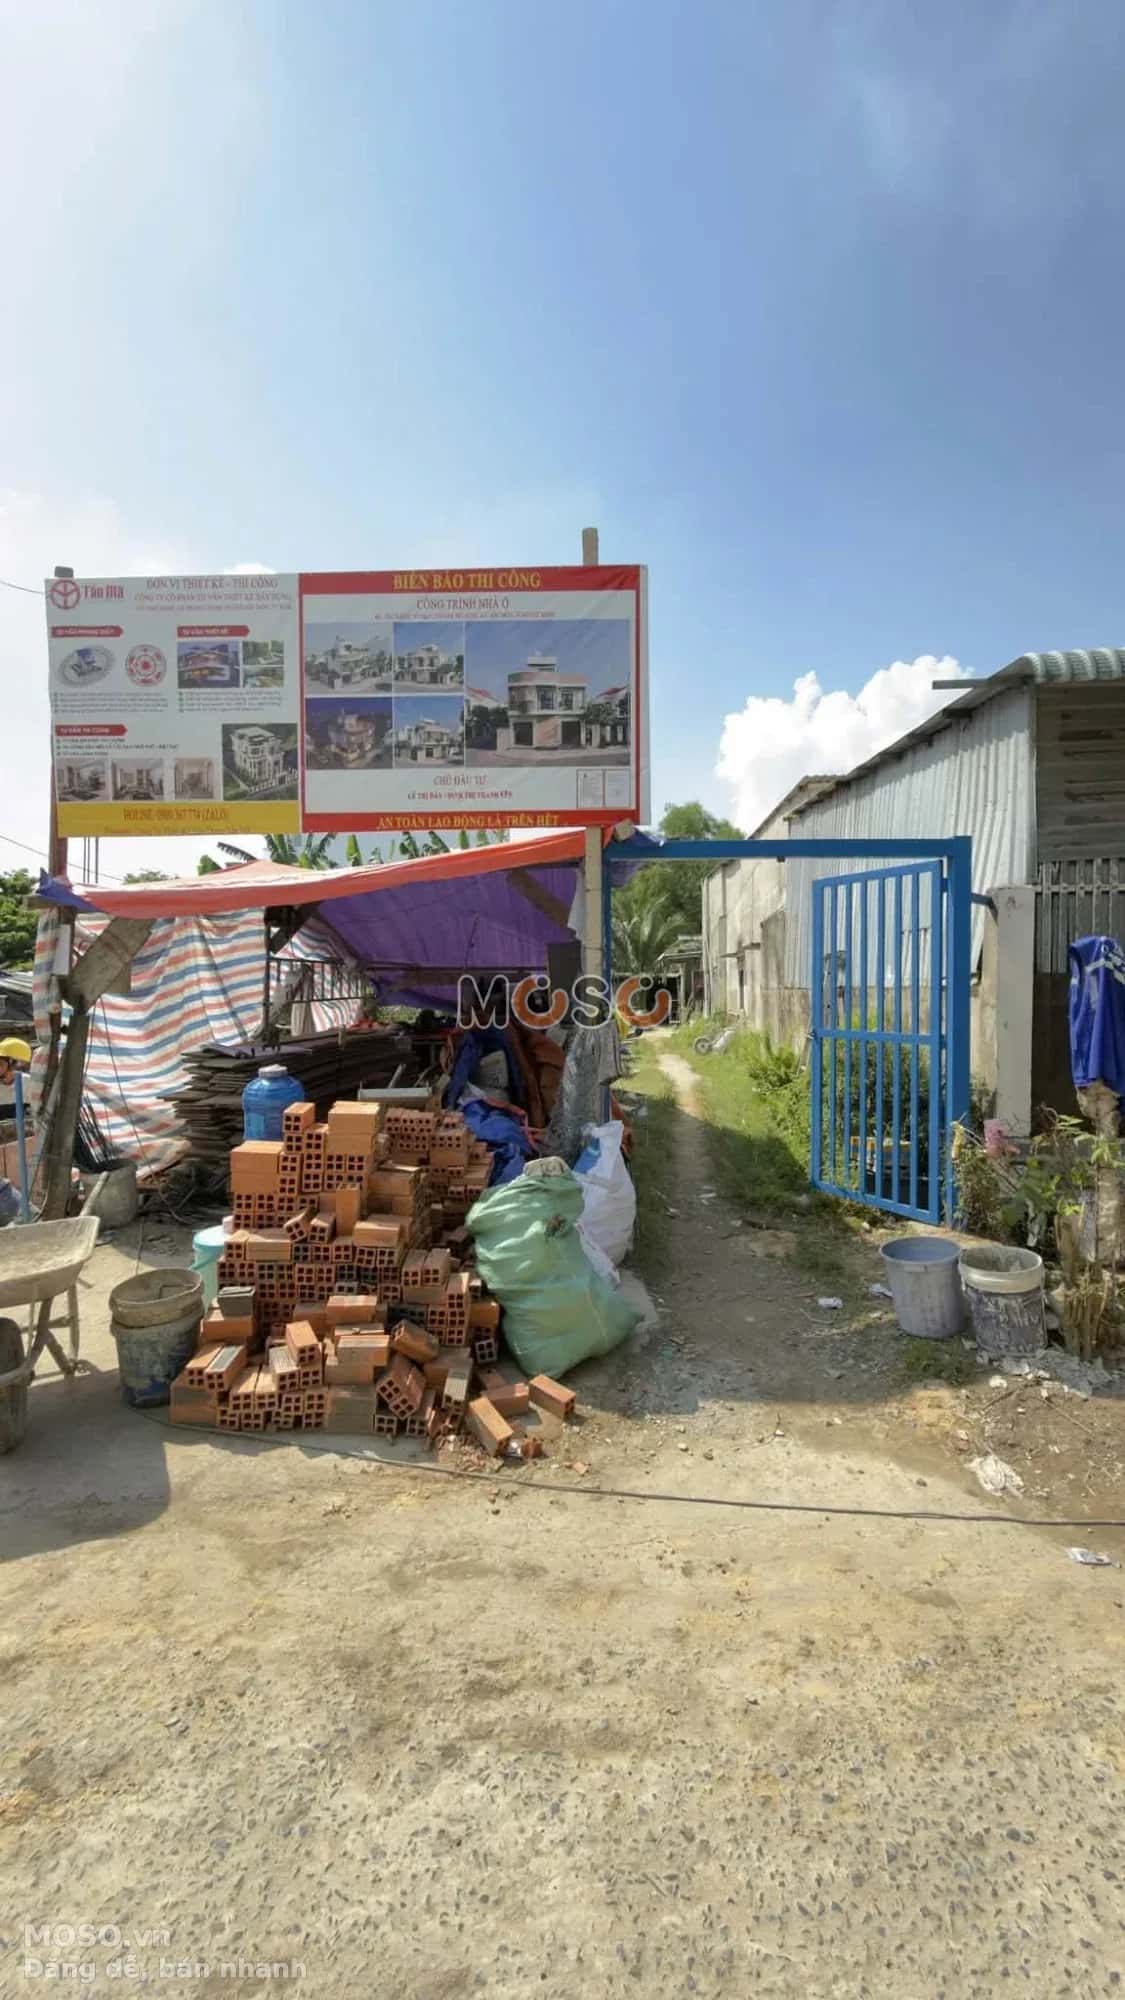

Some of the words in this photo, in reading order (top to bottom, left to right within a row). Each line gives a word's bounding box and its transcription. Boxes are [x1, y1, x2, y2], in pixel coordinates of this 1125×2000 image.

[468, 572, 493, 588] THI
[499, 569, 541, 588] CÔNG
[416, 596, 446, 609] CÔNG
[447, 595, 477, 609] TRÌNH
[478, 595, 499, 609] NHÀ
[378, 816, 394, 830] AN
[396, 814, 425, 829] TOÀN
[428, 816, 450, 829] LAO
[505, 812, 534, 827] TRÊN
